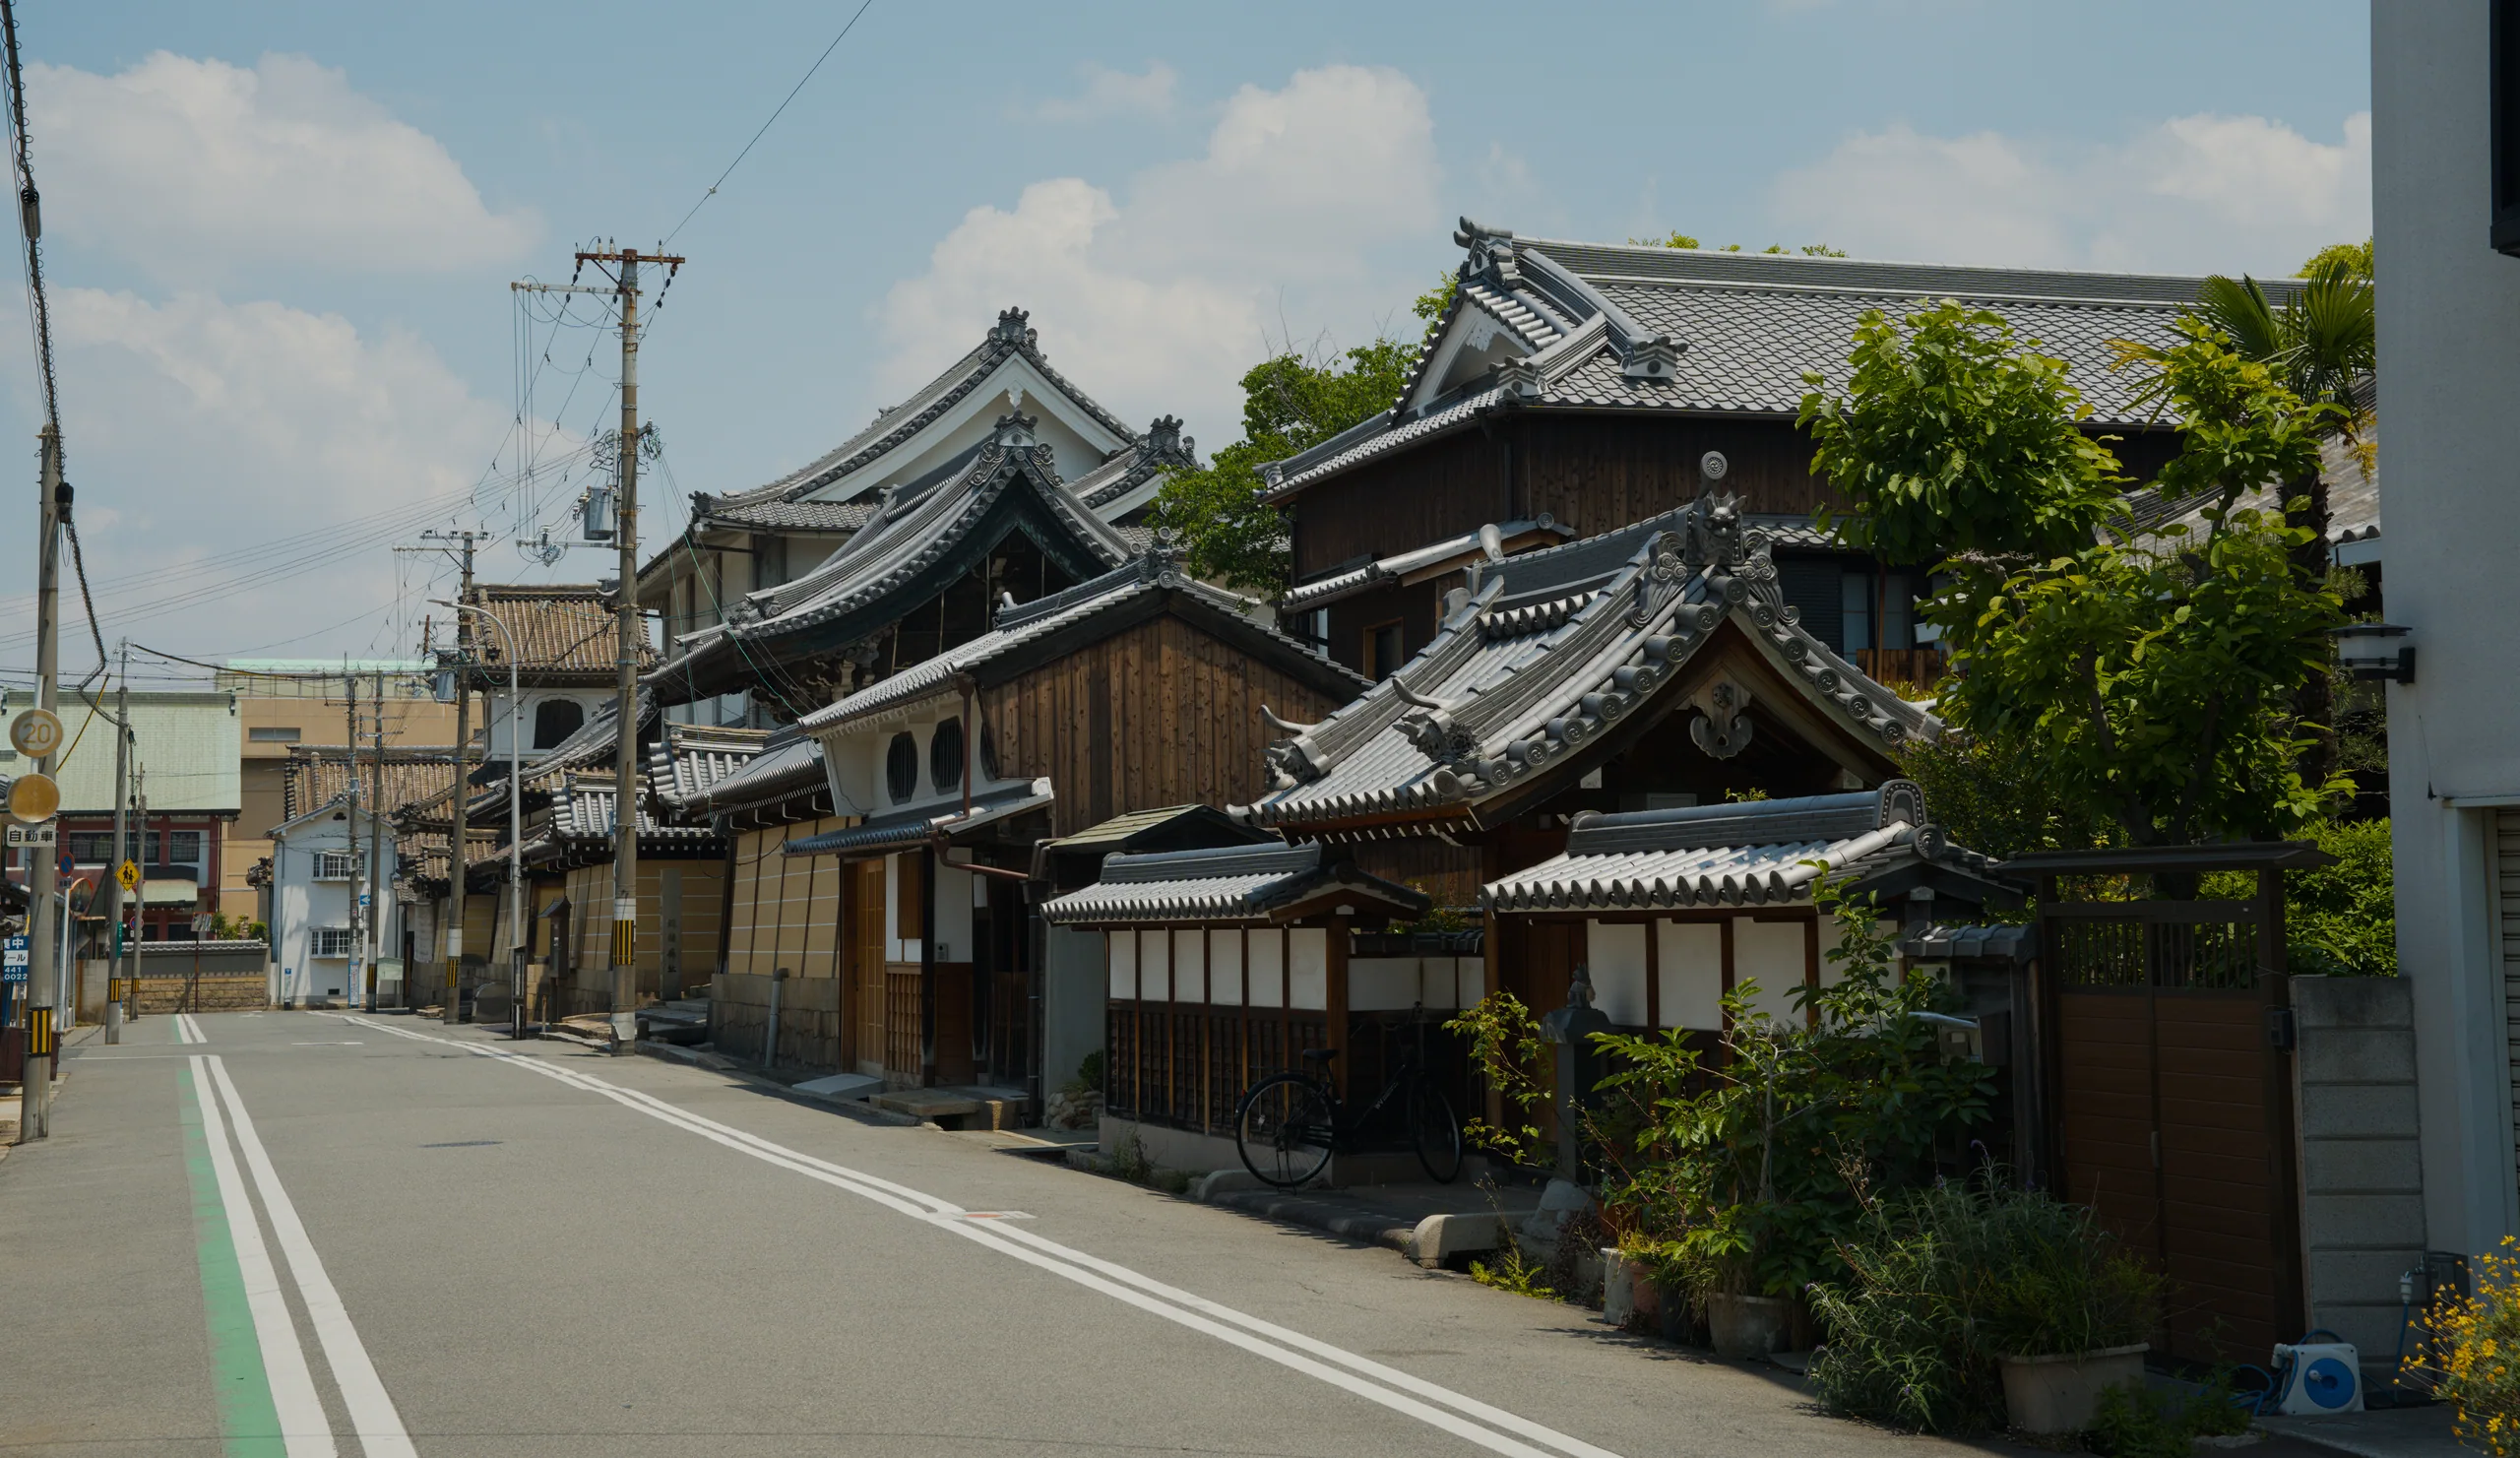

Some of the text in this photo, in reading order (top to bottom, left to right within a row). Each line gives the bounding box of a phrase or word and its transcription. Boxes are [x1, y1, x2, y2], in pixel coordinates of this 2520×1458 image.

[23, 724, 51, 743] 20
[9, 830, 53, 843] 自動車
